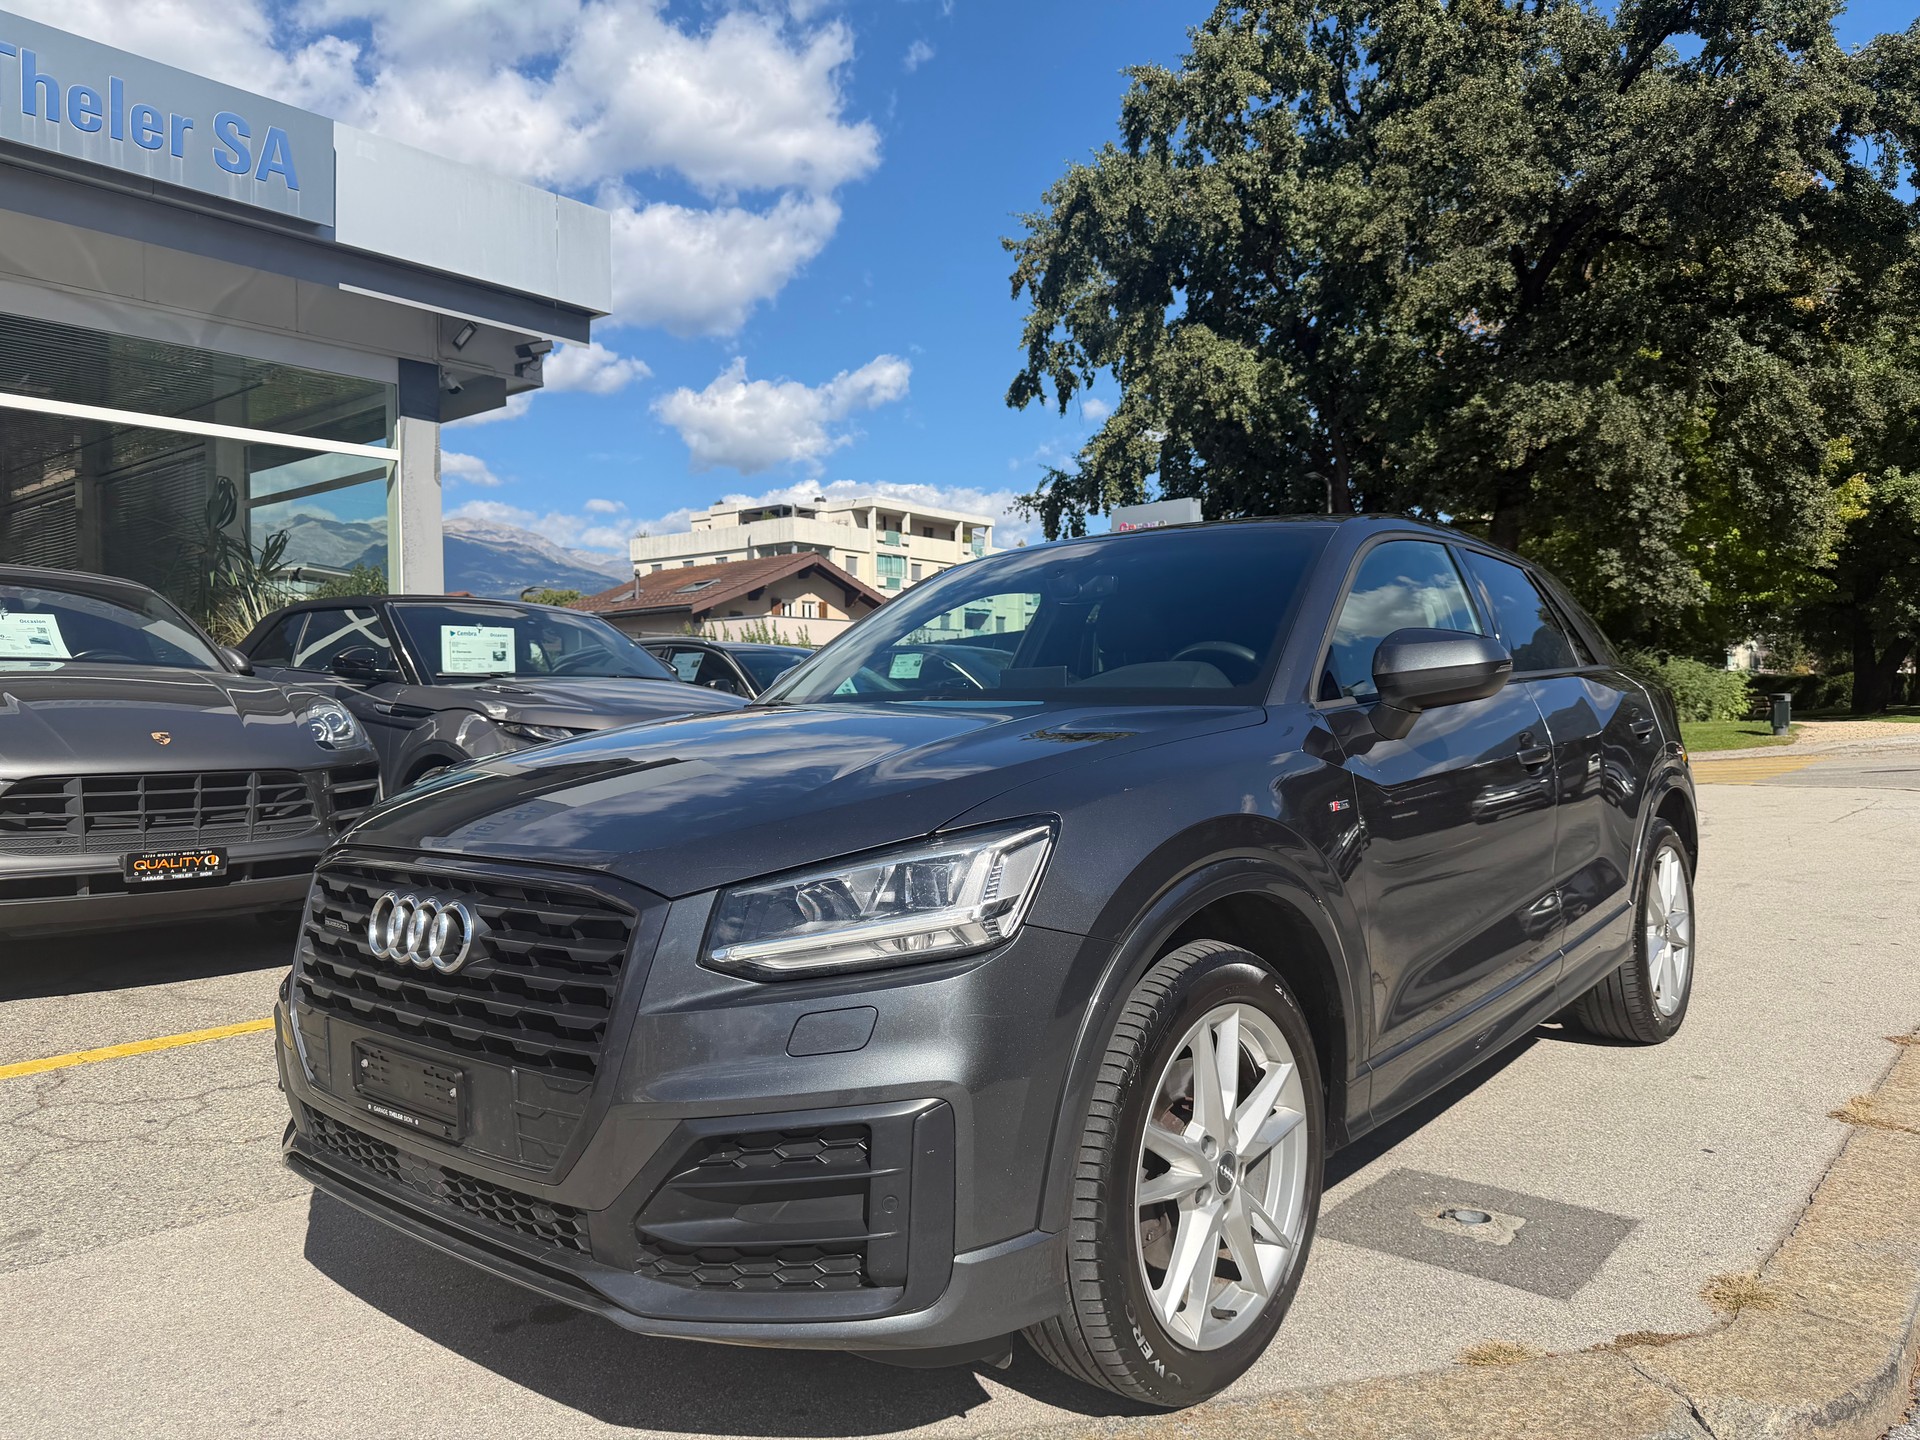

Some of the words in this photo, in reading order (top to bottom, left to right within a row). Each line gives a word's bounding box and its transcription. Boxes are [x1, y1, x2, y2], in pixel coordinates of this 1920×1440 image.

[212, 111, 300, 191] SA
[134, 856, 204, 870] QUALITY
[373, 1106, 388, 1115] GARAGE
